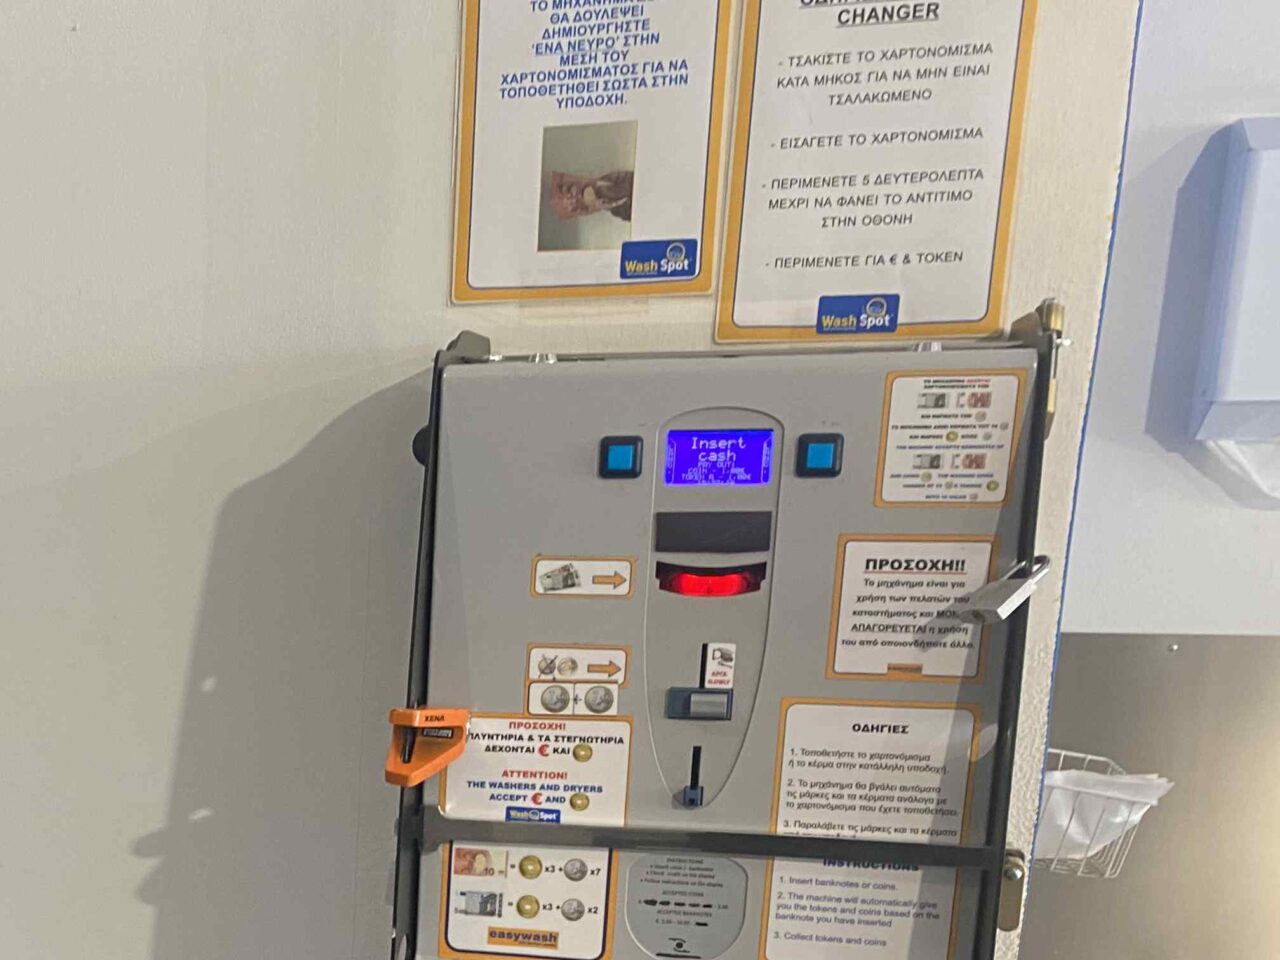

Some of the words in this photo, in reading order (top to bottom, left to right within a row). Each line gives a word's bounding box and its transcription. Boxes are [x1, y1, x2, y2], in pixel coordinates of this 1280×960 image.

[531, 0, 548, 12] ΤΟ
[550, 13, 569, 24] ΘΑ
[573, 5, 644, 23] ΔΟΥΛΕΨΕΙ
[837, 3, 940, 25] CHANGER
[542, 19, 650, 40] ΔΗΜΙΟΥΡΓΗΣΤΕ
[623, 33, 660, 47] ΣΤΗΝ
[560, 53, 597, 67] ΜΕΣΗ
[602, 50, 629, 62] ΤΟΥ
[788, 54, 850, 67] ΤΣΑΚΙΣΤΕ
[857, 51, 875, 62] ΤΟ
[880, 43, 993, 61] ΧΑΡΤΟΝΟΜΙΣΜΑ
[501, 64, 638, 85] ΧΑΡΤΟΝΟΜΙΣΜΑΤΟΣ
[642, 61, 664, 73] ΓΙΑ
[668, 59, 688, 72] ΝΑ
[777, 77, 809, 88] ΚΑΤΑ
[814, 73, 863, 86] ΜΗΚΟΣ
[867, 71, 888, 82] ΓΙΑ
[893, 70, 911, 80] ΝΑ
[916, 67, 948, 80] ΜΗΝ
[953, 64, 990, 77] ΕΙΝΑΙ
[500, 80, 599, 99] ΤΟΠΟΘΕΤΗΘΕΙ
[603, 77, 647, 91] ΣΩΣΤΑ
[652, 74, 688, 87] ΣΤΗΝ
[557, 93, 627, 109] ΥΠΟΔΟΧΗ.
[829, 89, 932, 105] ΤΣΑΛΑΚΩΜΕΝΟ
[780, 136, 843, 150] ΕΙΣΑΓΕΤΕ
[848, 134, 867, 146] ΤΟ
[871, 127, 984, 145] ΧΑΡΤΟΝΟΜΙΣΜΑ
[771, 175, 857, 190] ΠΕΡΙΜΕΝΕΤΕ
[862, 175, 870, 186] 5
[873, 168, 984, 185] ΔΕΥΤΕΡΟΛΕΠΤΑ
[769, 198, 809, 210] ΜΕΧΡΙ
[814, 197, 832, 208] ΝΑ
[837, 195, 879, 207] ΦΑΝΕΙ
[884, 194, 902, 205] ΤΟ
[906, 190, 973, 204] ΑΝΤΙΤΙΜΟ
[822, 216, 856, 228] ΣΤΗΝ
[862, 214, 912, 226] ΟΘΟΝΗ
[625, 260, 658, 273] Wash
[660, 259, 689, 273] Spot
[774, 255, 860, 268] ΠΕΡΙΜΕΝΕΤΕ
[865, 255, 885, 266] ΓΙΑ
[890, 254, 897, 265] €
[902, 254, 911, 264] &
[917, 251, 963, 264] TOKEN
[822, 315, 856, 327] Wash
[859, 314, 890, 328] Spot
[691, 437, 746, 449] Insert
[699, 450, 736, 462] cash
[866, 558, 966, 571] ΠΡΟΣΟΧΗ!!
[877, 579, 924, 588] μηχάνημα
[856, 595, 886, 603] χρήση
[852, 610, 917, 619] καταστήματος
[851, 624, 926, 633] ΑΠΑΓΟΡΕΥΕΤΑΙ
[509, 721, 566, 730] ΠΡΟΣΟΧΗ!
[852, 723, 909, 734] ΟΔΗΓΙΕΣ
[554, 735, 624, 744] ΣΤΕΓΝΩΤΗΡΙΑ
[485, 745, 535, 753] ΔΕΧΟΝΤΑΙ
[538, 744, 550, 757] €
[502, 770, 568, 779] ATTENTION!
[489, 782, 536, 790] WASHERS
[564, 785, 603, 793] DRYERS
[489, 793, 528, 801] ACCEPT
[531, 793, 543, 805] €
[540, 812, 556, 820] Spot
[545, 865, 555, 873] x3
[789, 877, 813, 885] Insert
[815, 878, 859, 889] banknotes
[489, 931, 557, 942] easywash
[784, 932, 813, 941] Collect
[815, 934, 843, 943] tokens
[845, 937, 862, 945] and
[864, 938, 886, 946] coins
